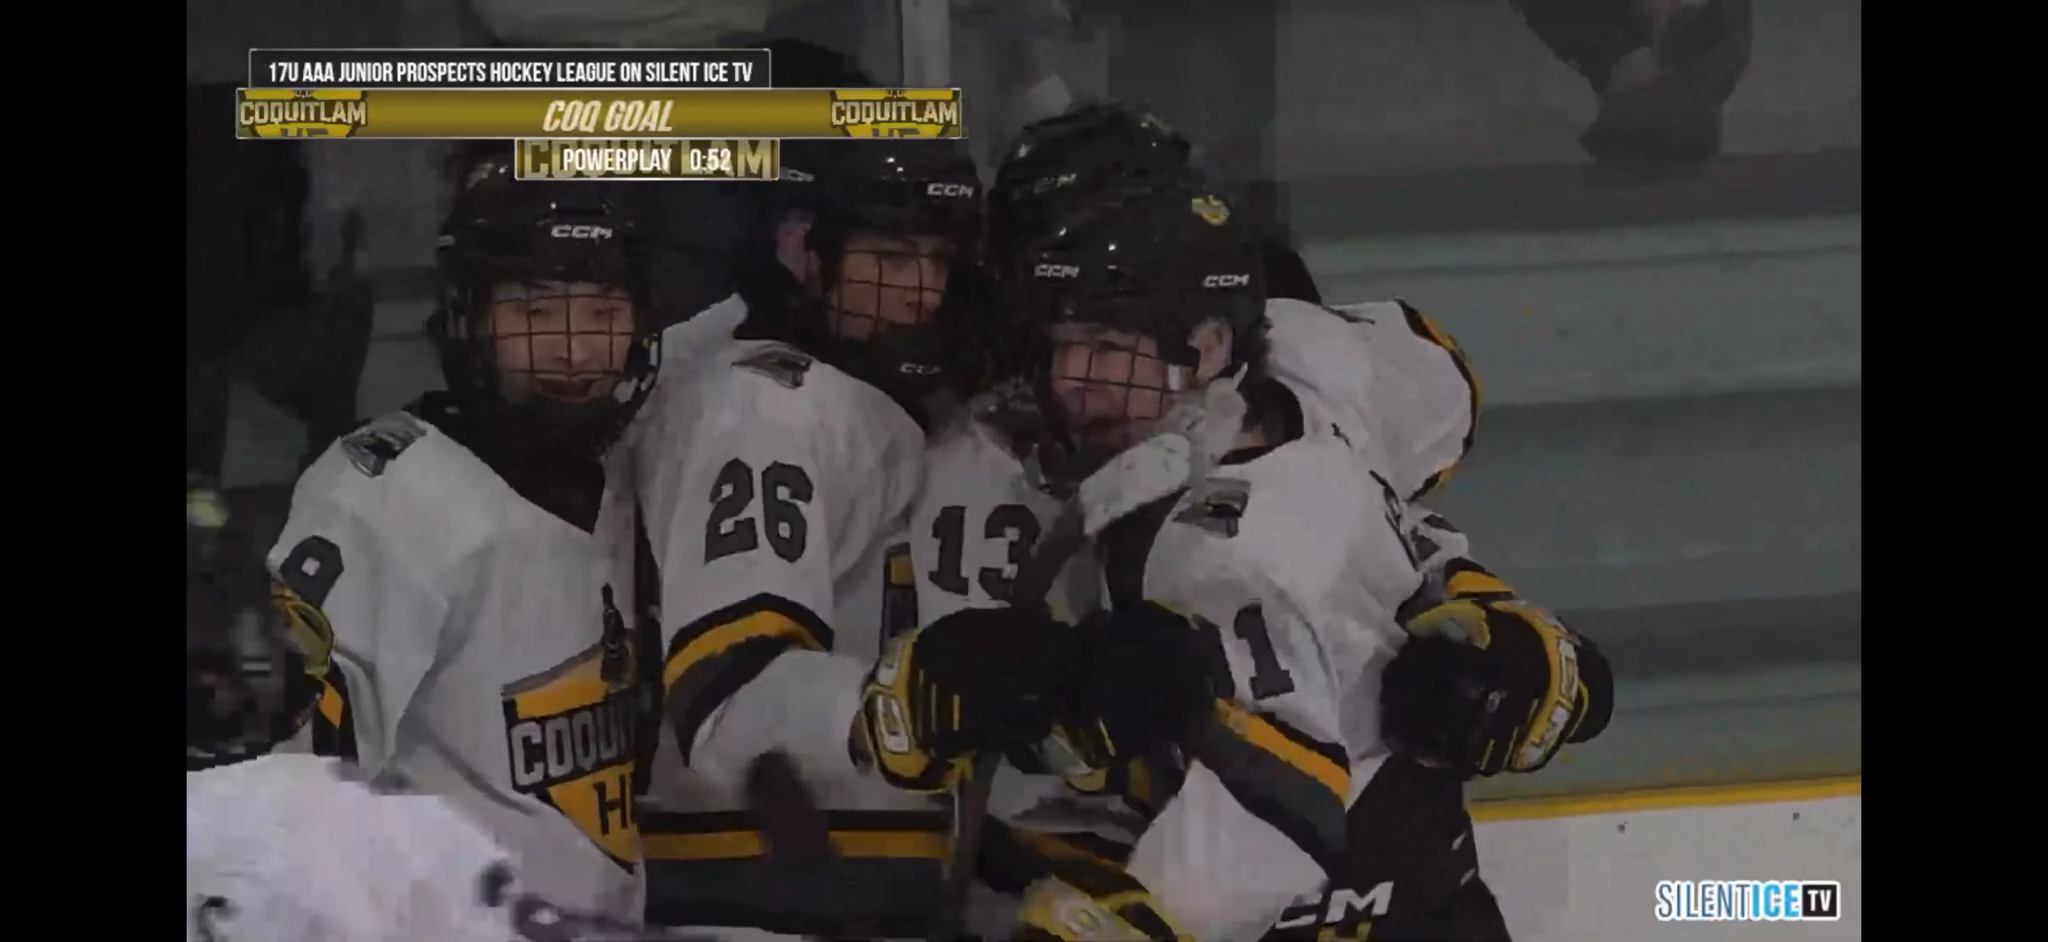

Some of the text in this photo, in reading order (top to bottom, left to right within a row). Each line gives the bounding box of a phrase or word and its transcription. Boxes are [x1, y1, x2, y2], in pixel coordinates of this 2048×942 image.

[926, 182, 975, 199] CCM
[551, 224, 613, 239] CCM
[1033, 263, 1080, 278] CCM
[1203, 273, 1250, 289] CCM
[704, 457, 814, 565] 26
[927, 503, 1042, 601] 13
